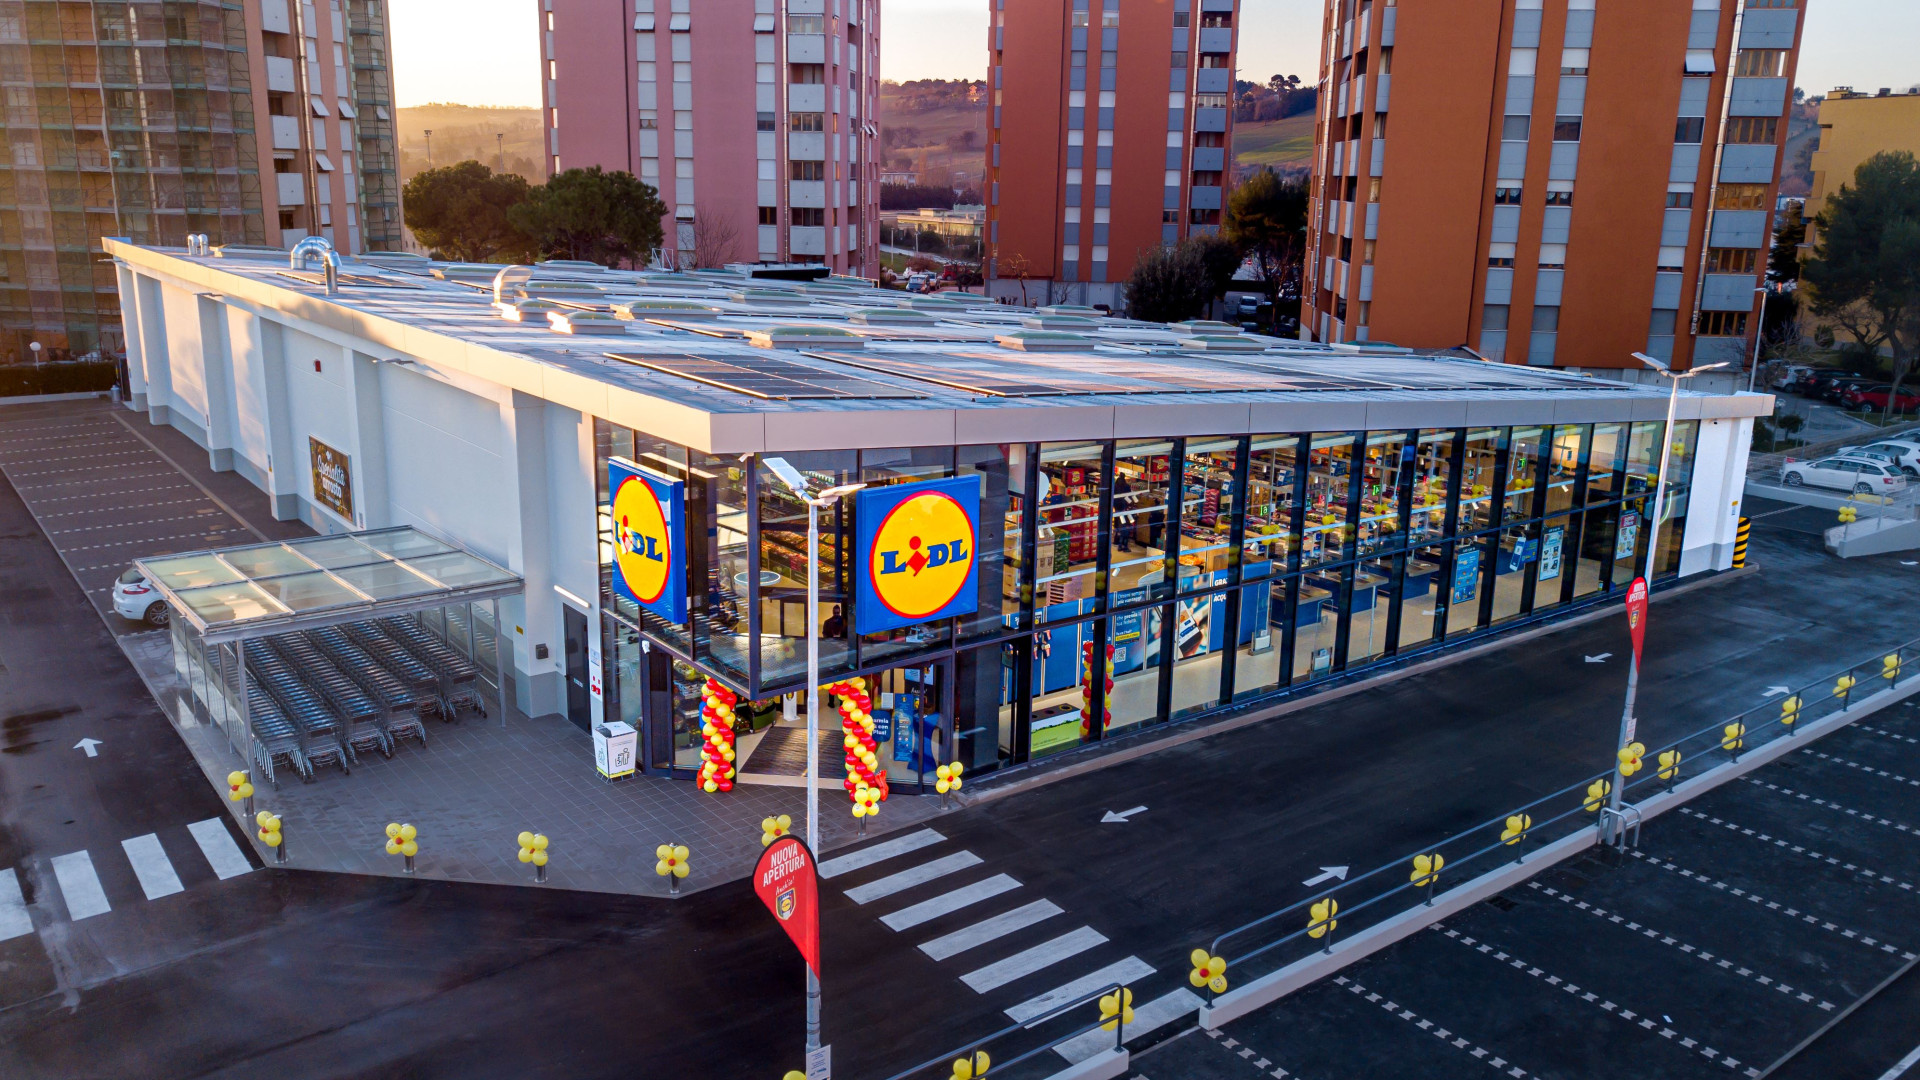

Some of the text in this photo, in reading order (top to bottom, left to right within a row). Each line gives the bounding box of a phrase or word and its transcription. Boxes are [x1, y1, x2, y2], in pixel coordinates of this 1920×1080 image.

[614, 515, 663, 562] LIDL
[880, 536, 968, 577] LIDL
[1214, 578, 1229, 587] GRA
[763, 853, 806, 887] APERTURA
[771, 842, 798, 868] NUOVA
